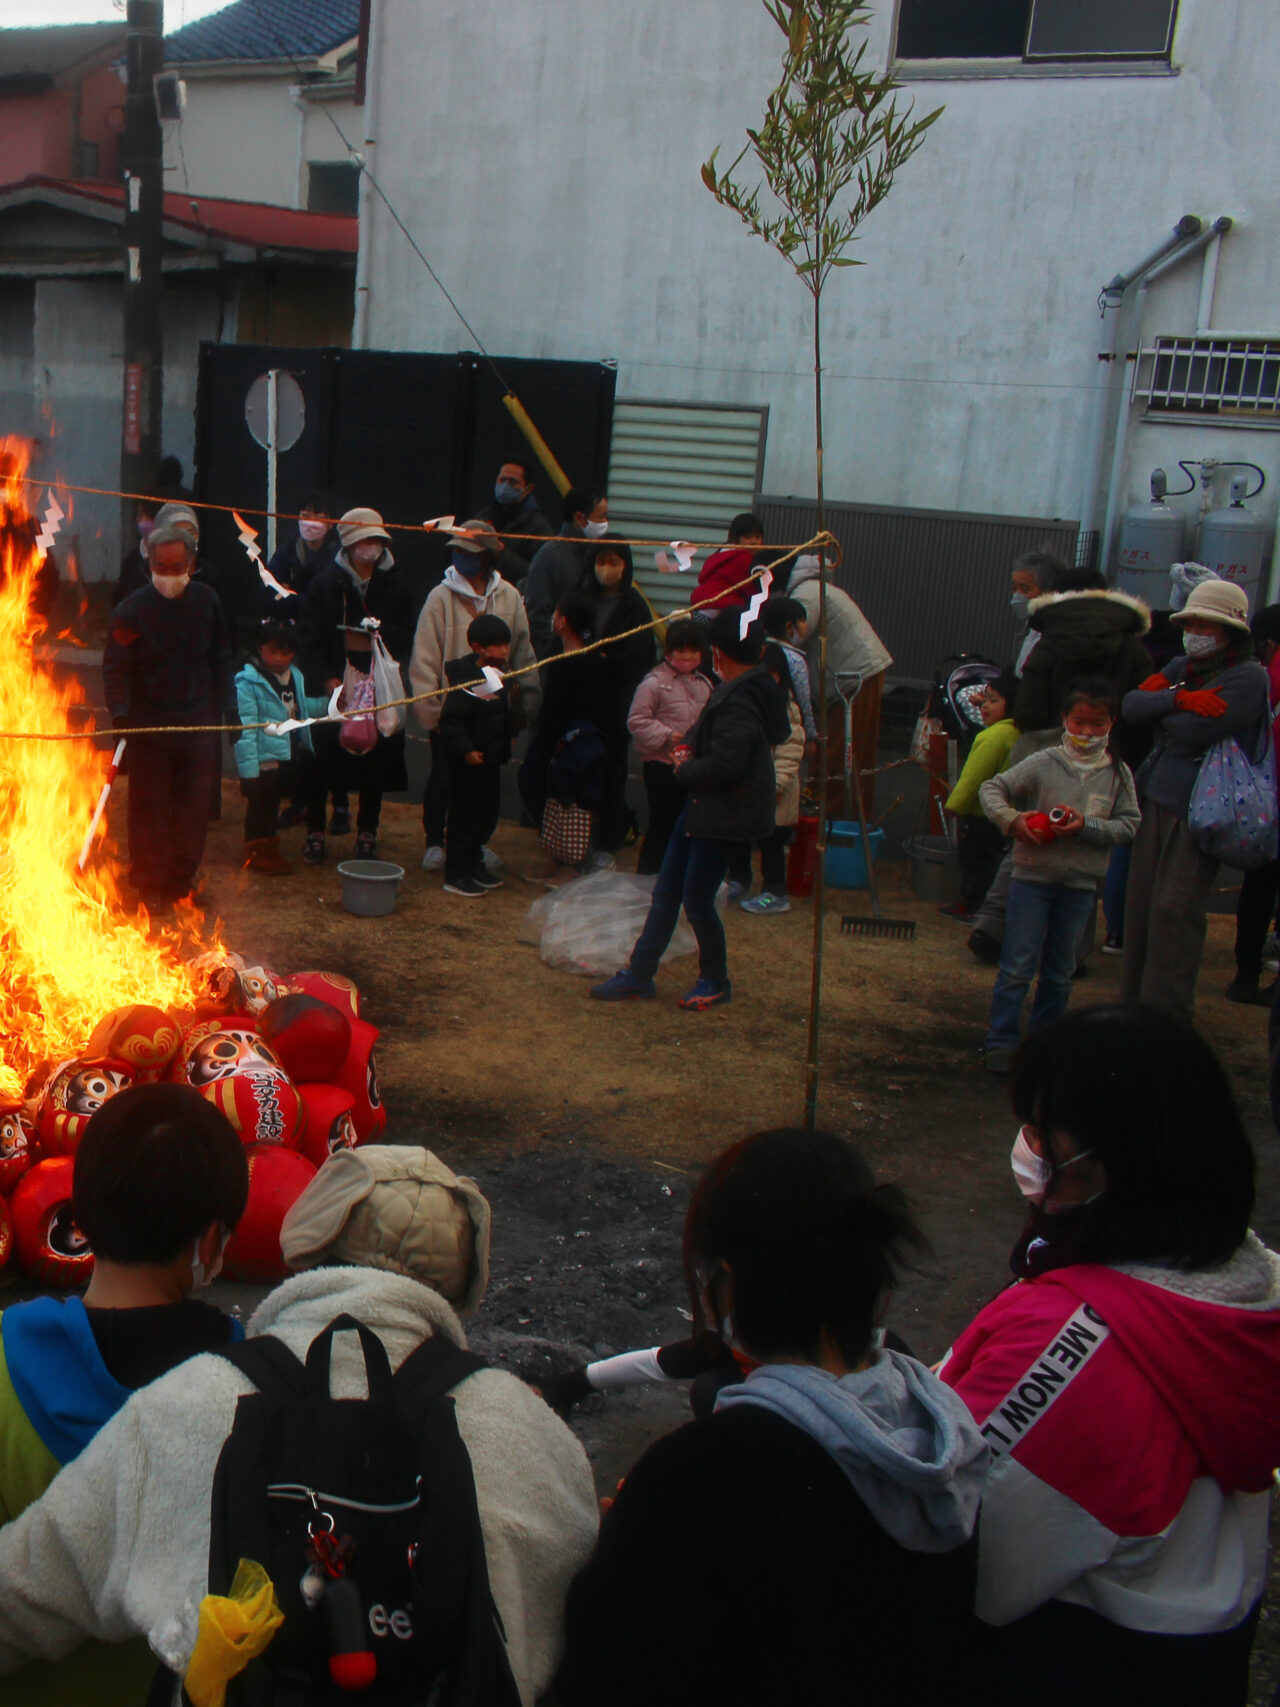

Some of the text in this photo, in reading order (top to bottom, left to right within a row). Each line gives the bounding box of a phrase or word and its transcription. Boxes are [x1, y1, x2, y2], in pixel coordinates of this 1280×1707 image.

[251, 1079, 286, 1141] ユタカ建設
[1047, 1321, 1098, 1372] ME
[999, 1362, 1066, 1433] NOW
